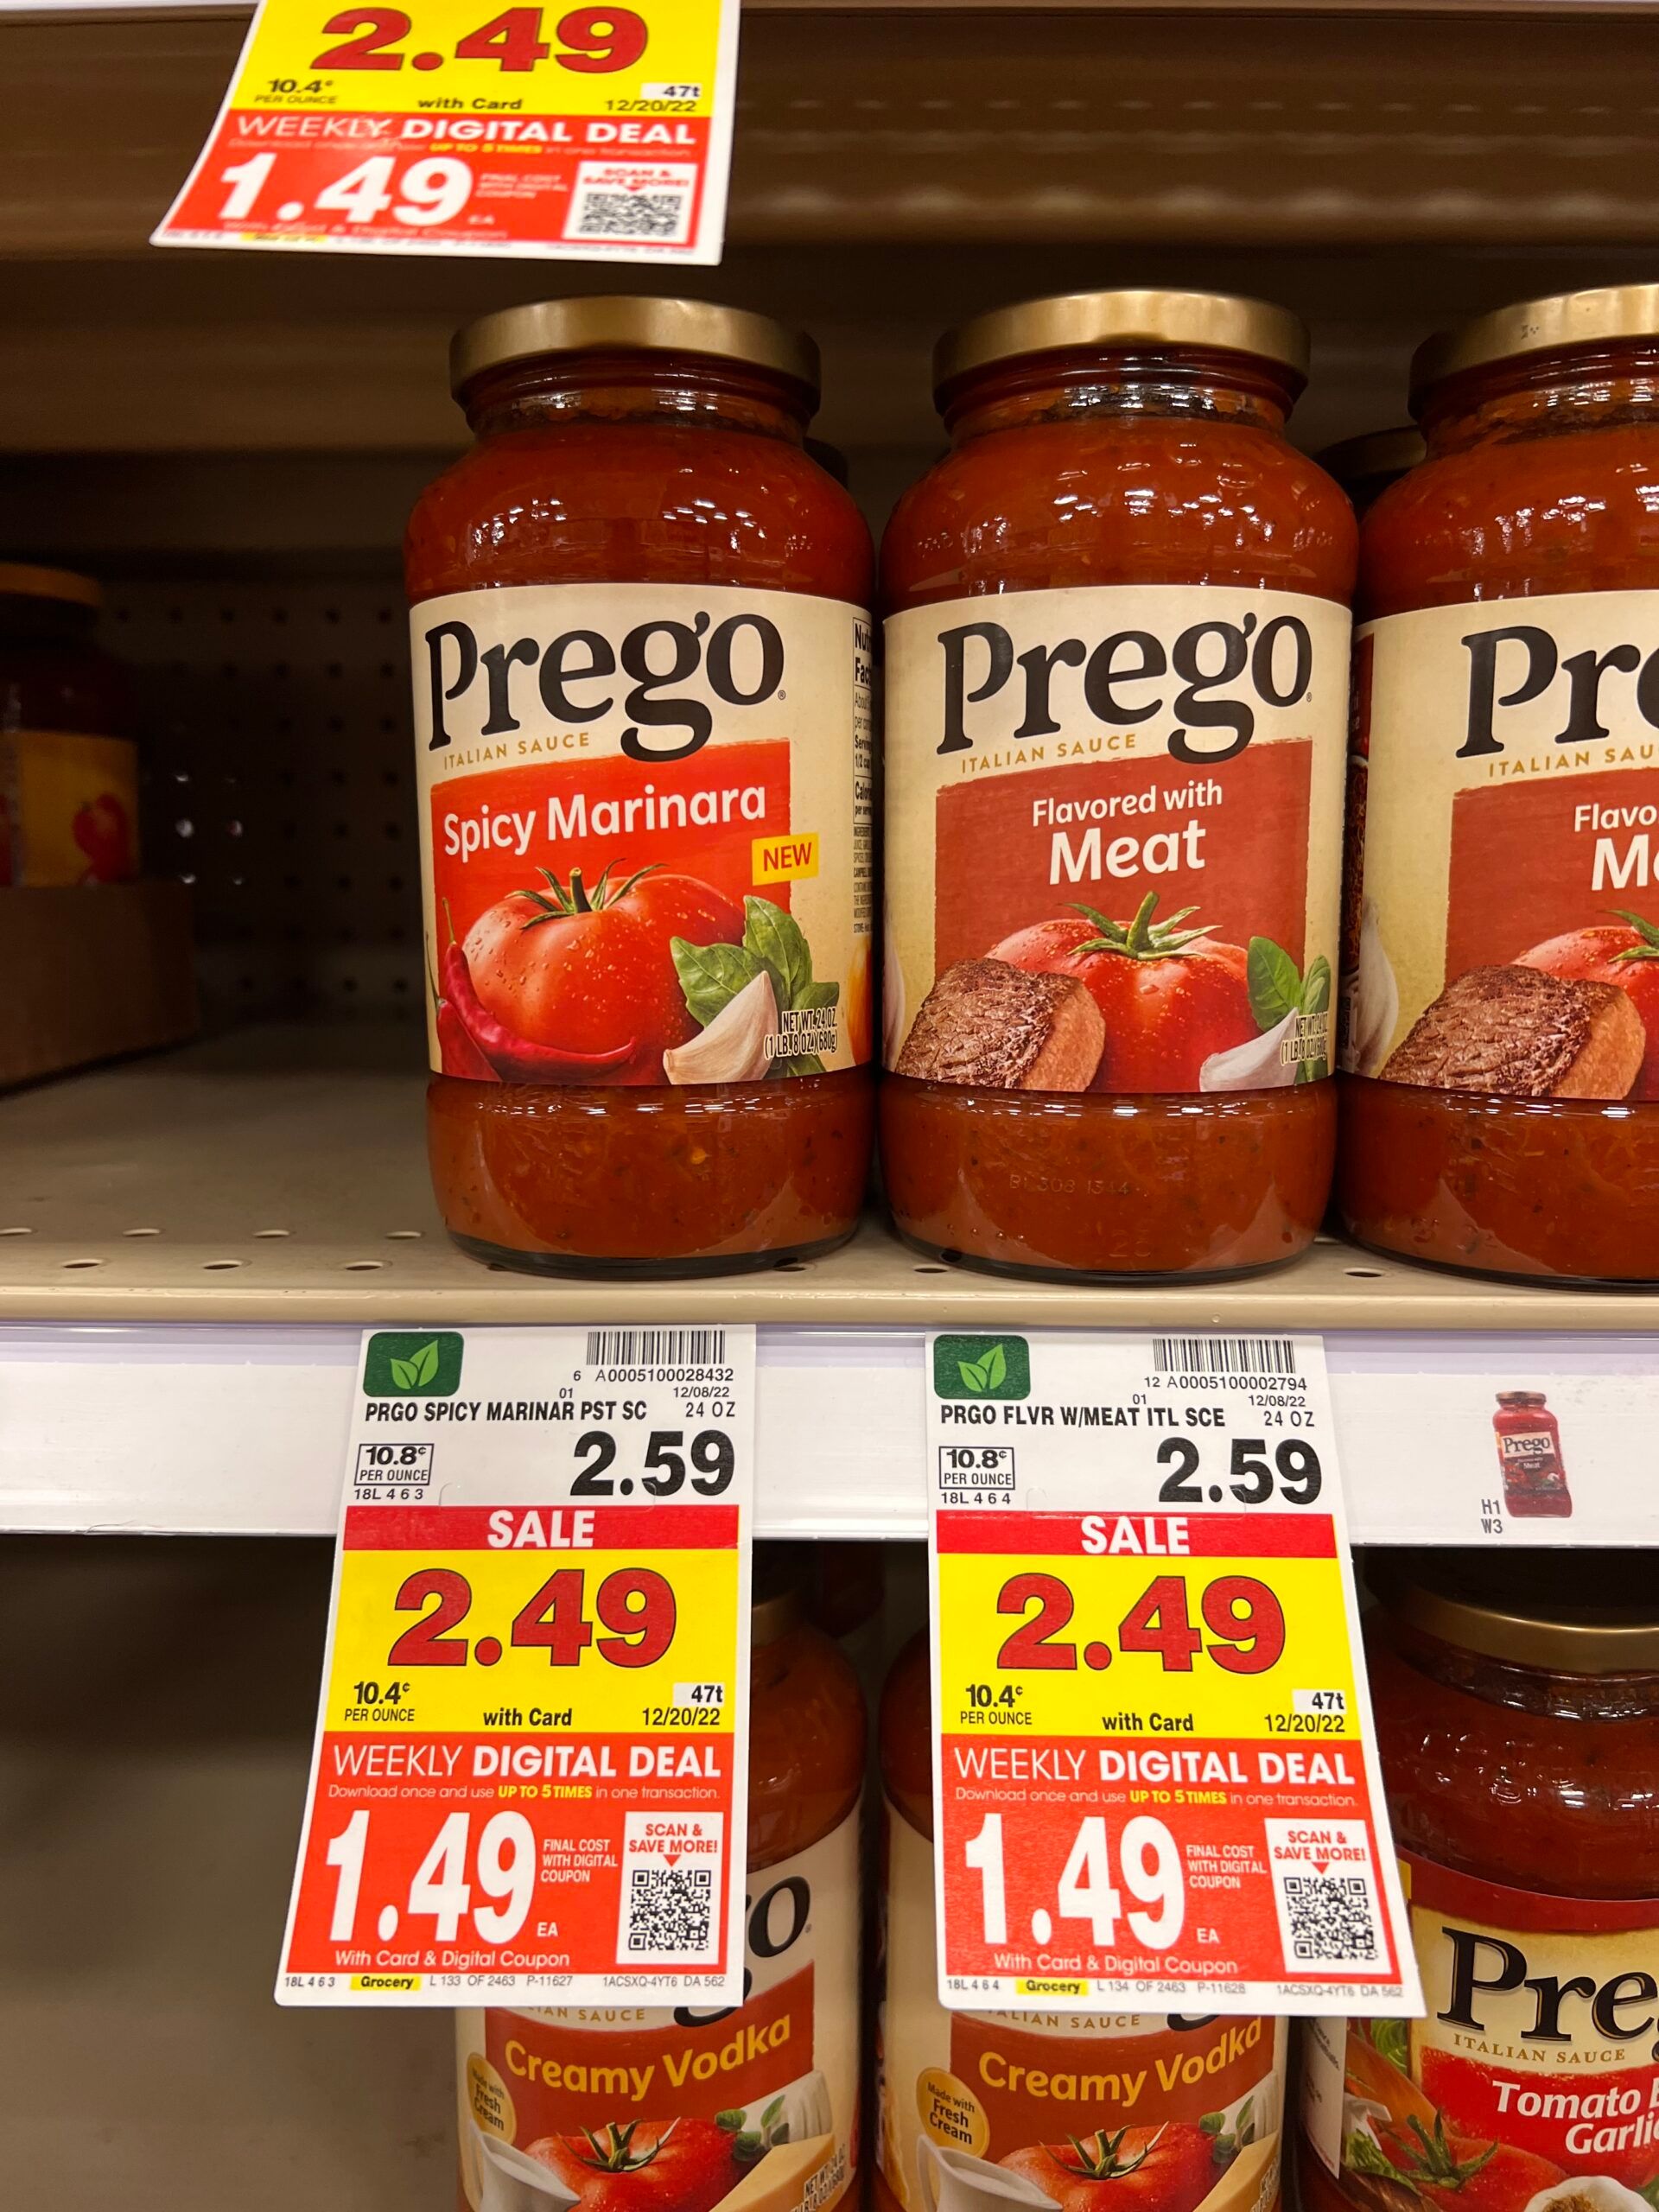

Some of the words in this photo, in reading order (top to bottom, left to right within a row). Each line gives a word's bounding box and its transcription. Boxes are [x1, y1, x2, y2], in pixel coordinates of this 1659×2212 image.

[310, 7, 648, 73] 2.49
[254, 95, 283, 104] PER
[287, 95, 338, 104] OUNCE
[663, 86, 701, 98] 47t
[417, 98, 463, 110] with
[471, 98, 524, 111] Card
[605, 99, 697, 112] 12/20/22
[238, 116, 392, 138] WEEKLY
[402, 119, 572, 143] DIGITAL
[587, 123, 696, 144] DEAL
[218, 152, 474, 226] 1.49
[424, 611, 785, 762] Prego
[936, 612, 1313, 764] Prego
[443, 746, 508, 771] ITALIAN
[518, 733, 591, 756] SAUCE
[961, 746, 1044, 773] ITALIAN
[1057, 734, 1136, 757] SAUCE
[1489, 752, 1591, 777] ITALIAN
[1604, 744, 1659, 764] SAU
[1032, 785, 1156, 827] Flavored
[1163, 779, 1224, 810] with
[444, 804, 536, 863] Spicy
[548, 785, 766, 841] Marinara
[1574, 804, 1659, 832] Flavo
[762, 842, 813, 872] NEW
[1049, 819, 1206, 886] Meat
[783, 1012, 799, 1033] NET
[800, 1010, 814, 1031] WT.
[573, 1370, 582, 1381] 6
[595, 1368, 734, 1382] A0005100028432
[1144, 1376, 1160, 1388] 12
[1166, 1376, 1308, 1391] A0005100002794
[558, 1388, 573, 1399] 01
[673, 1386, 730, 1398] 12/08/22
[1132, 1394, 1147, 1405] 01
[1248, 1394, 1306, 1408] 12/08/22
[365, 1403, 417, 1422] PRGO
[423, 1402, 480, 1421] SPICY
[486, 1402, 574, 1421] MARINAR
[580, 1401, 617, 1421] PST
[621, 1401, 648, 1421] SC
[685, 1402, 704, 1418] 24
[711, 1402, 736, 1418] OZ
[940, 1405, 997, 1425] PRGO
[1003, 1406, 1054, 1426] FLVR
[1060, 1407, 1140, 1427] W/MEAT
[1147, 1408, 1179, 1427] ITL
[1185, 1408, 1225, 1427] SCE
[1263, 1410, 1284, 1427] 24
[1290, 1410, 1315, 1427] OZ
[1503, 1437, 1550, 1456] Prego
[569, 1428, 735, 1497] 2.59
[1156, 1436, 1322, 1505] 2.59
[359, 1470, 384, 1482] PER
[387, 1469, 429, 1482] OUNCE
[944, 1473, 968, 1485] PER
[971, 1473, 1013, 1486] OUNCE
[353, 1488, 382, 1500] 18L
[386, 1488, 396, 1500] 4
[400, 1488, 410, 1500] 6
[415, 1488, 424, 1500] 3
[1481, 1499, 1501, 1515] H1
[486, 1509, 597, 1548] SALE
[1080, 1515, 1191, 1555] SALE
[1481, 1519, 1503, 1535] W3
[387, 1567, 677, 1669] 2.49
[996, 1572, 1286, 1675] 2.49
[690, 1684, 724, 1703] 47t
[1311, 1692, 1344, 1710] 47t
[344, 1708, 369, 1722] PER
[372, 1708, 416, 1722] OUNCE
[483, 1707, 524, 1726] with
[529, 1707, 573, 1726] Card
[642, 1707, 721, 1726] 12/20/22
[960, 1711, 985, 1725] PER
[988, 1711, 1033, 1726] OUNCE
[1102, 1713, 1144, 1731] with
[1149, 1713, 1194, 1732] Card
[1264, 1713, 1345, 1733] 12/20/22
[334, 1745, 463, 1777] WEEKLY
[474, 1745, 617, 1777] DIGITAL
[629, 1745, 721, 1777] DEAL
[954, 1748, 1087, 1780] WEEKLY
[1098, 1750, 1249, 1783] DIGITAL
[1258, 1752, 1356, 1785] DEAL
[328, 1784, 397, 1798] Download
[400, 1787, 436, 1798] once
[439, 1785, 467, 1798] and
[470, 1788, 495, 1798] use
[498, 1785, 518, 1798] UP
[519, 1785, 538, 1798] TO
[541, 1783, 552, 1798] 5
[553, 1785, 593, 1798] TIMES
[595, 1785, 608, 1799] in
[611, 1788, 639, 1799] one
[642, 1786, 721, 1799] transaction.
[645, 1823, 688, 1837] SCAN
[692, 1823, 703, 1837] &
[1287, 1830, 1332, 1844] SCAN
[1337, 1831, 1347, 1844] &
[543, 1839, 576, 1852] FINAL
[578, 1839, 611, 1852] COST
[629, 1840, 665, 1853] SAVE
[669, 1840, 718, 1853] MORE!
[1186, 1845, 1220, 1858] FINAL
[1222, 1845, 1255, 1858] COST
[1274, 1846, 1311, 1859] SAVE
[1316, 1847, 1366, 1861] MORE!
[543, 1854, 571, 1867] WITH
[573, 1854, 619, 1867] DIGITAL
[1188, 1859, 1218, 1873] WITH
[1220, 1860, 1268, 1874] DIGITAL
[325, 1809, 537, 1944] 1.49
[541, 1869, 590, 1883] COUPON
[965, 1812, 1185, 1950] 1.49
[1189, 1875, 1241, 1889] COUPON
[537, 1922, 558, 1937] EA
[1197, 1928, 1220, 1943] EA
[335, 1949, 371, 1967] With
[376, 1949, 419, 1967] Card
[423, 1950, 436, 1967] &
[442, 1949, 496, 1971] Digital
[499, 1950, 570, 1970] Coupon
[360, 1975, 414, 1990] Grocery
[441, 1975, 461, 1986] 133
[467, 1975, 485, 1986] OF
[487, 1975, 516, 1986] 2463
[526, 1975, 574, 1986] P-11627
[683, 1975, 702, 1986] DA
[704, 1975, 725, 1986] 562
[1437, 1926, 1659, 2062] Pre
[578, 2008, 645, 2022] SAUCE
[1071, 2014, 1141, 2029] SAUCE
[505, 2039, 654, 2102] Creamy
[663, 2014, 791, 2088] Vodka
[1454, 2033, 1546, 2063] ITALIAN
[1556, 2048, 1625, 2064] SAUCE
[979, 2051, 1147, 2107] Creamy
[1155, 2018, 1262, 2092] Vodka
[476, 2083, 501, 2114] Fresh
[927, 2082, 951, 2103] Made
[952, 2097, 975, 2113] with
[1492, 2081, 1641, 2120] Tomato
[474, 2097, 505, 2132] Cream
[933, 2098, 969, 2128] Fresh
[930, 2112, 973, 2145] Cream
[1565, 2113, 1659, 2155] Garli
